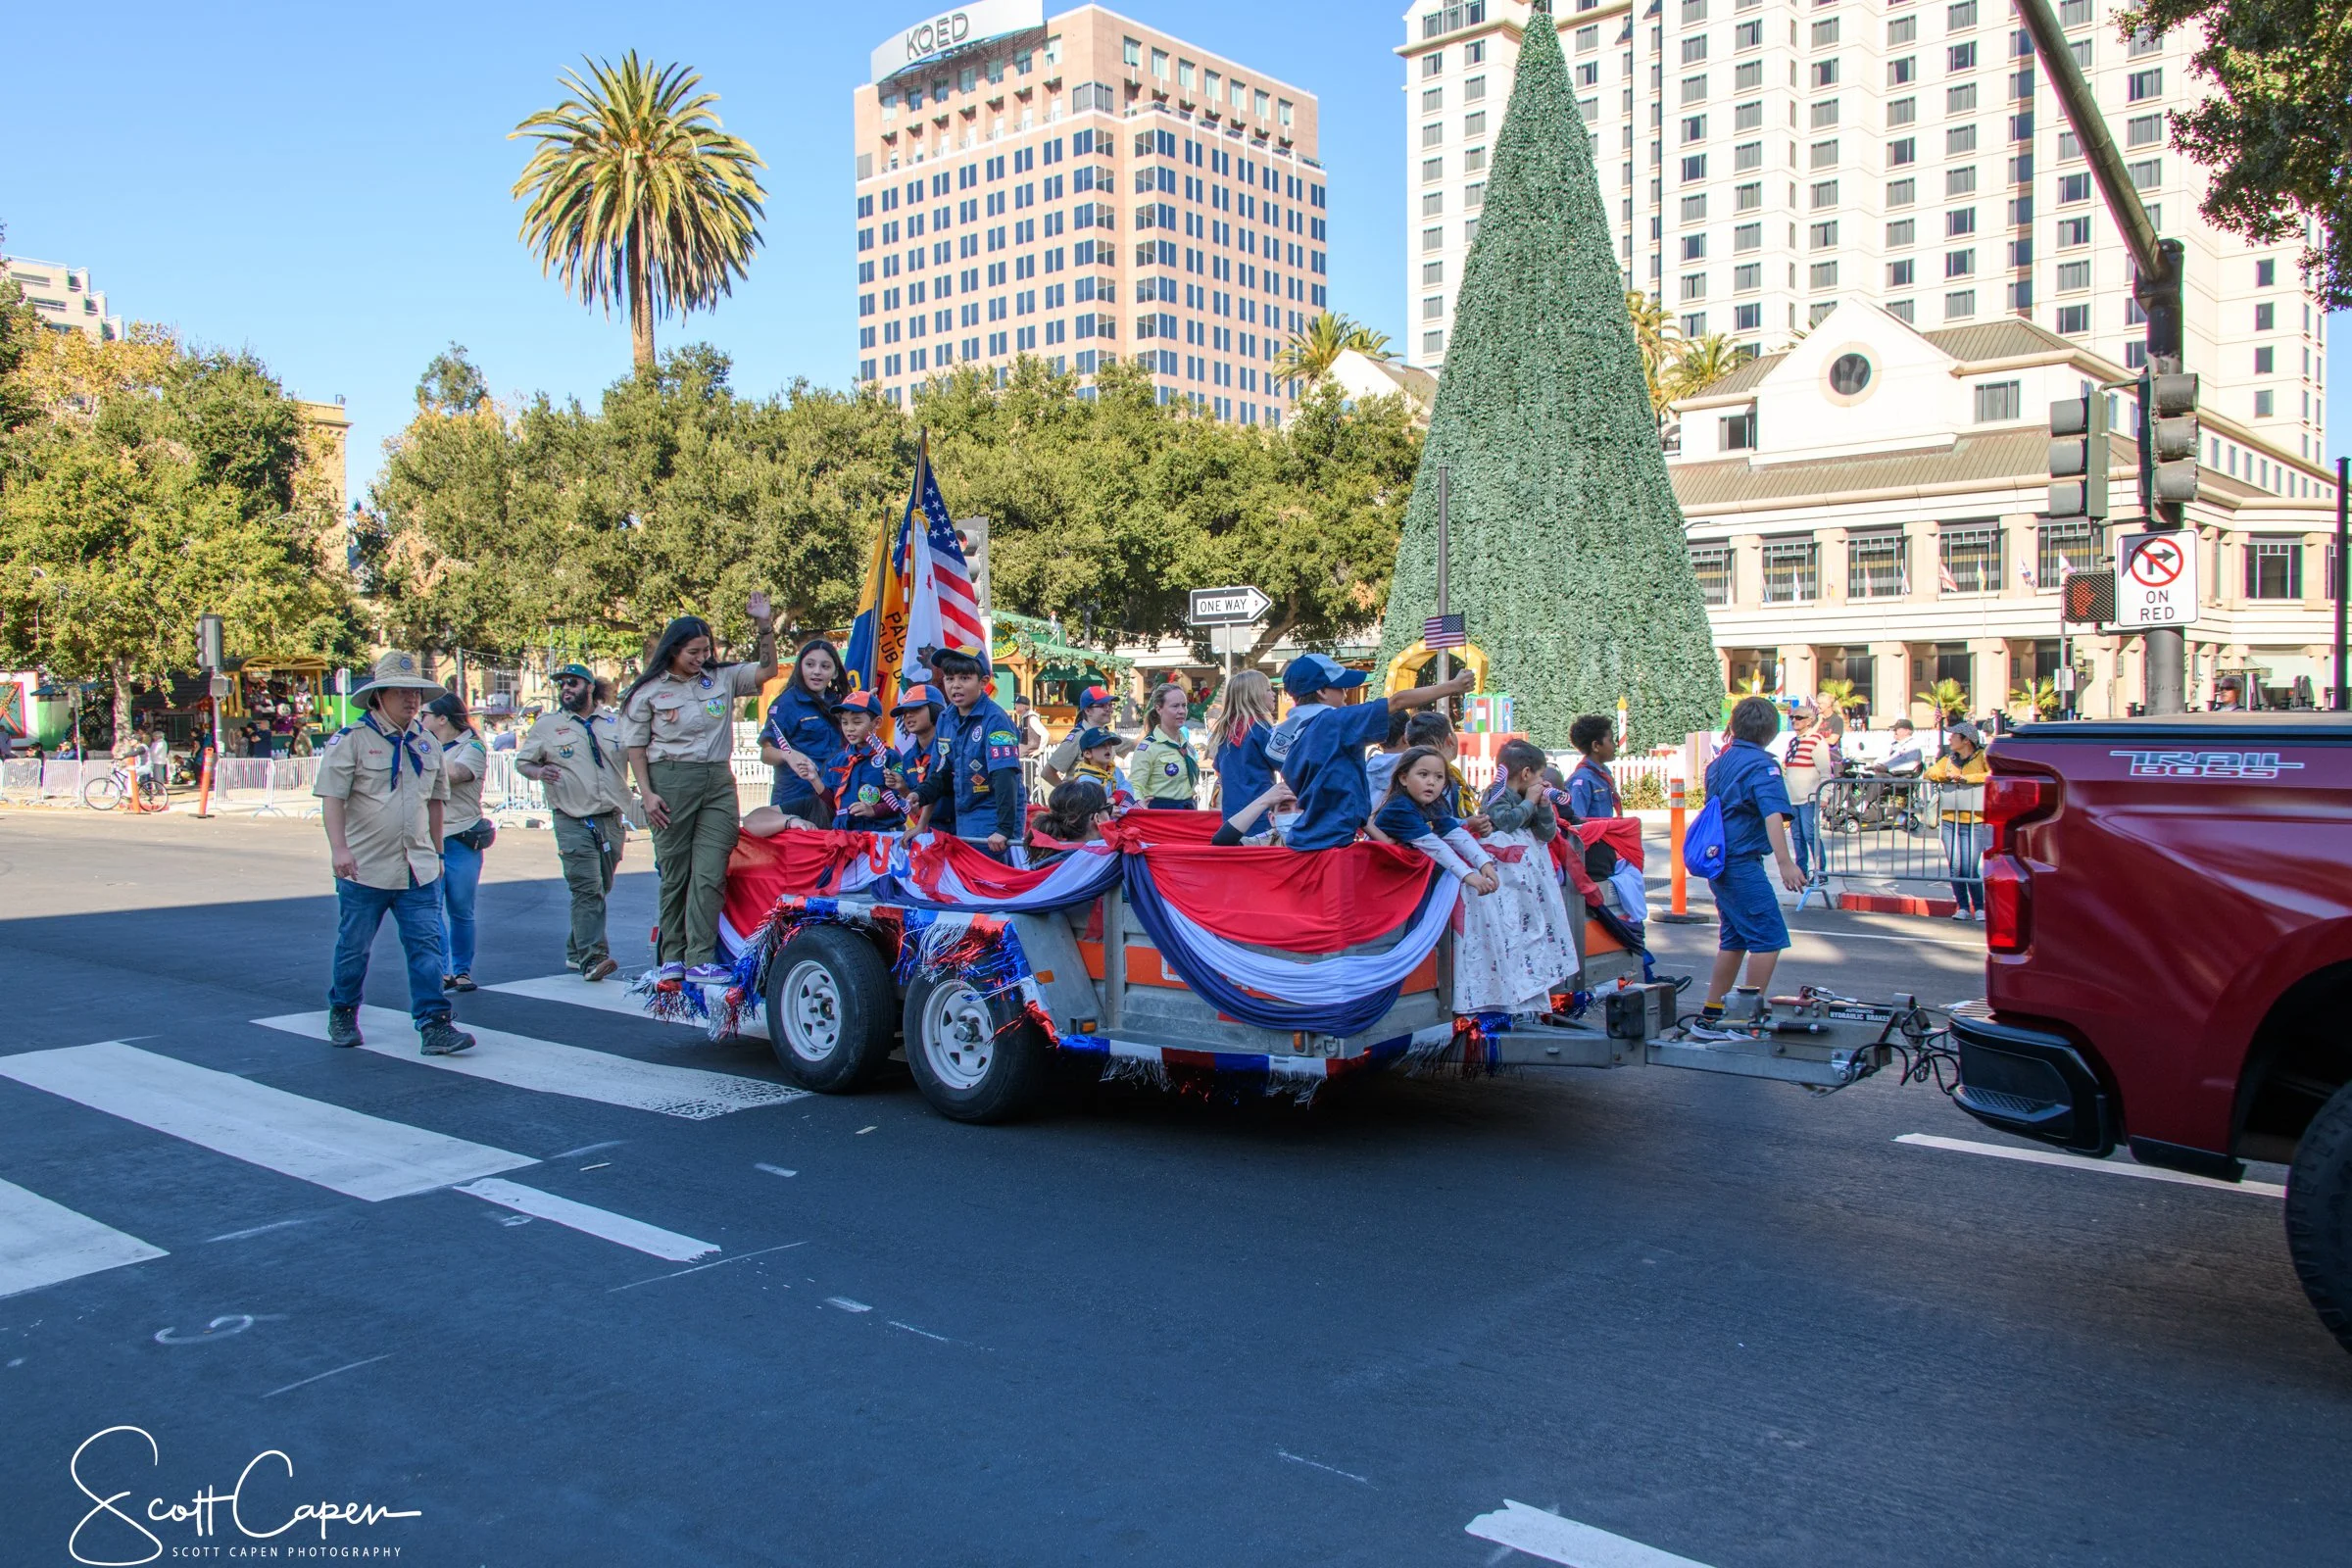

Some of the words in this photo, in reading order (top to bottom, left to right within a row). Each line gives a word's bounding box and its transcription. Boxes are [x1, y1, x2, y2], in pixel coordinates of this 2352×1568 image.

[906, 13, 970, 60] KQED
[2146, 590, 2169, 604] ON
[1200, 600, 1221, 612] ONE
[1225, 598, 1248, 611] WAY
[2140, 607, 2175, 621] RED
[993, 640, 1017, 658] PARK
[2109, 750, 2305, 769] TRAIL
[2130, 764, 2278, 779] BOSS
[1829, 1011, 1864, 1020] HYDRAULIC
[1866, 1013, 1890, 1022] BRAKES
